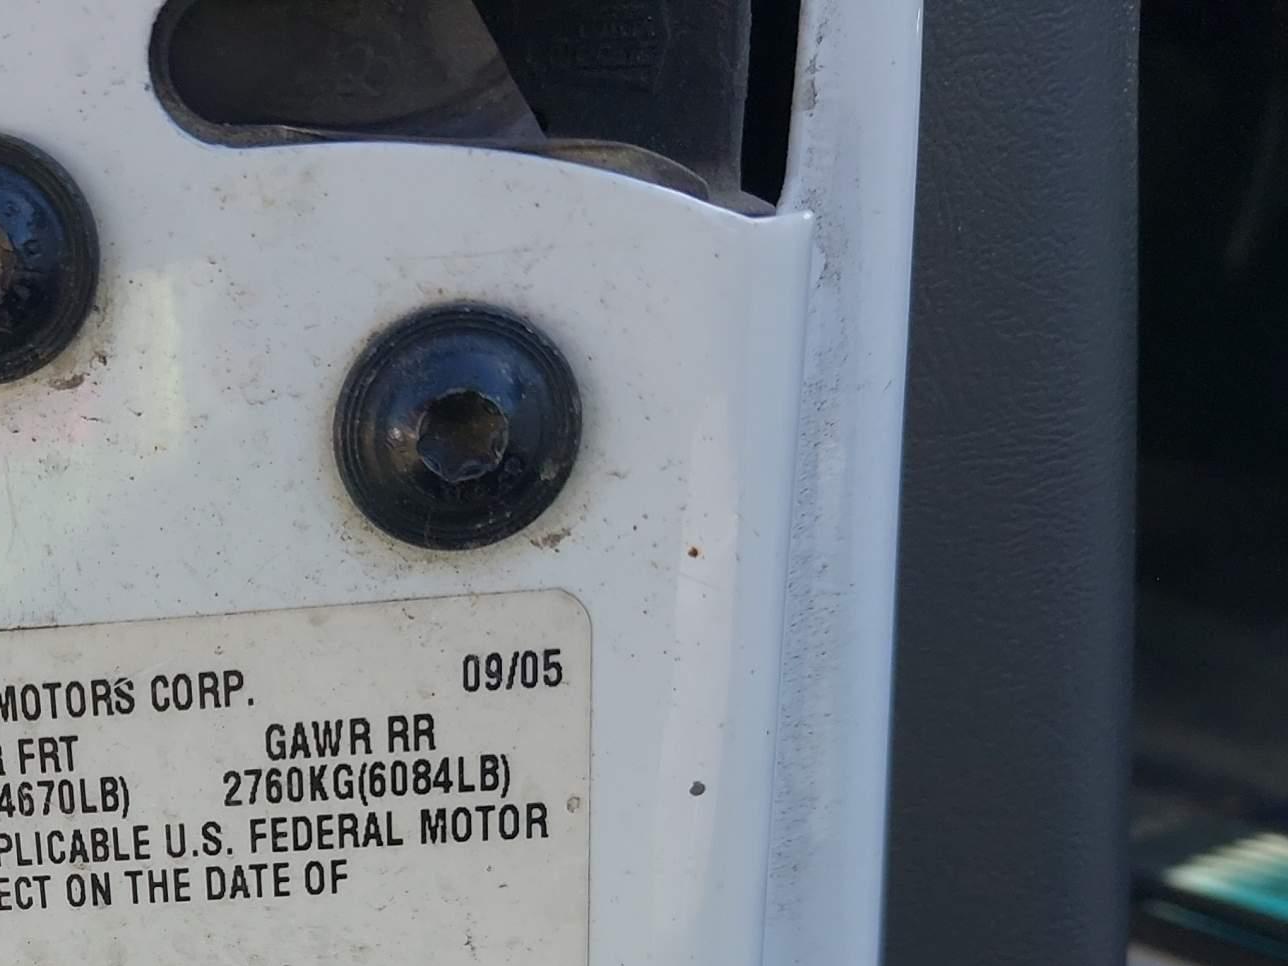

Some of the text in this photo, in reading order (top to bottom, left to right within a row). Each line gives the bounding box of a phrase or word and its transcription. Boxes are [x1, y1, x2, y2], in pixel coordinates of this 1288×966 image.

[151, 670, 254, 712] CORP.
[463, 648, 563, 692] 09/05
[18, 735, 78, 774] FRT
[265, 713, 436, 761] GAWR RR
[223, 754, 510, 806] 2760KG(6084LB)
[165, 821, 232, 858] U.S.
[250, 811, 403, 853] FEDERAL
[421, 802, 549, 844] MOTOR
[66, 872, 112, 907] ON
[124, 868, 191, 904] THE
[206, 862, 290, 900] DATE
[305, 859, 348, 895] OF
